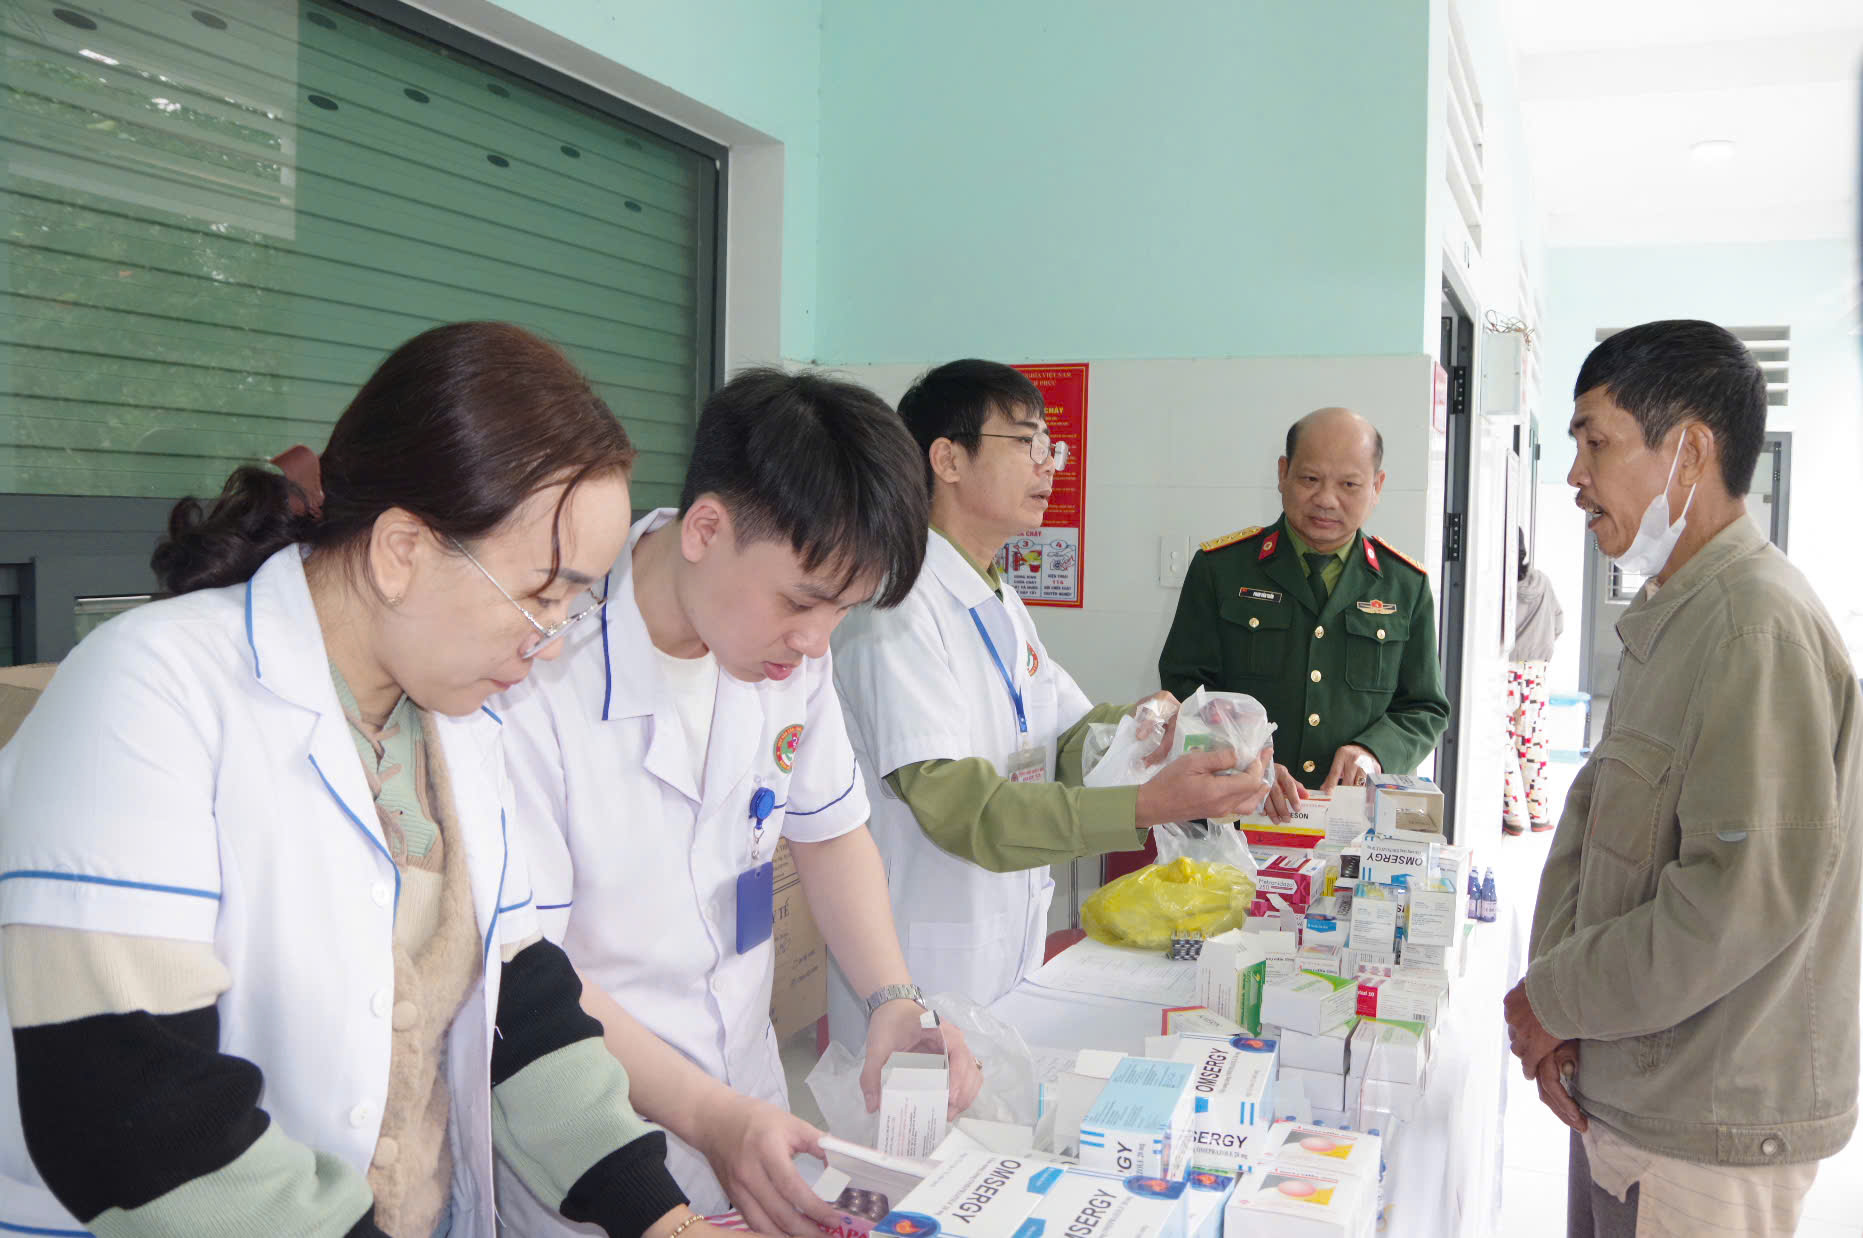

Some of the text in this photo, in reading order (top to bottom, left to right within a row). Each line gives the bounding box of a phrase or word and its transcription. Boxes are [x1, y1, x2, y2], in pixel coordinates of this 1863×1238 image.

[1022, 540, 1029, 548] 3
[1055, 541, 1063, 549] 4
[1366, 852, 1424, 867] OMSERGY
[1195, 1047, 1230, 1093] OMSERGY
[951, 1159, 1022, 1224] OMSERGY
